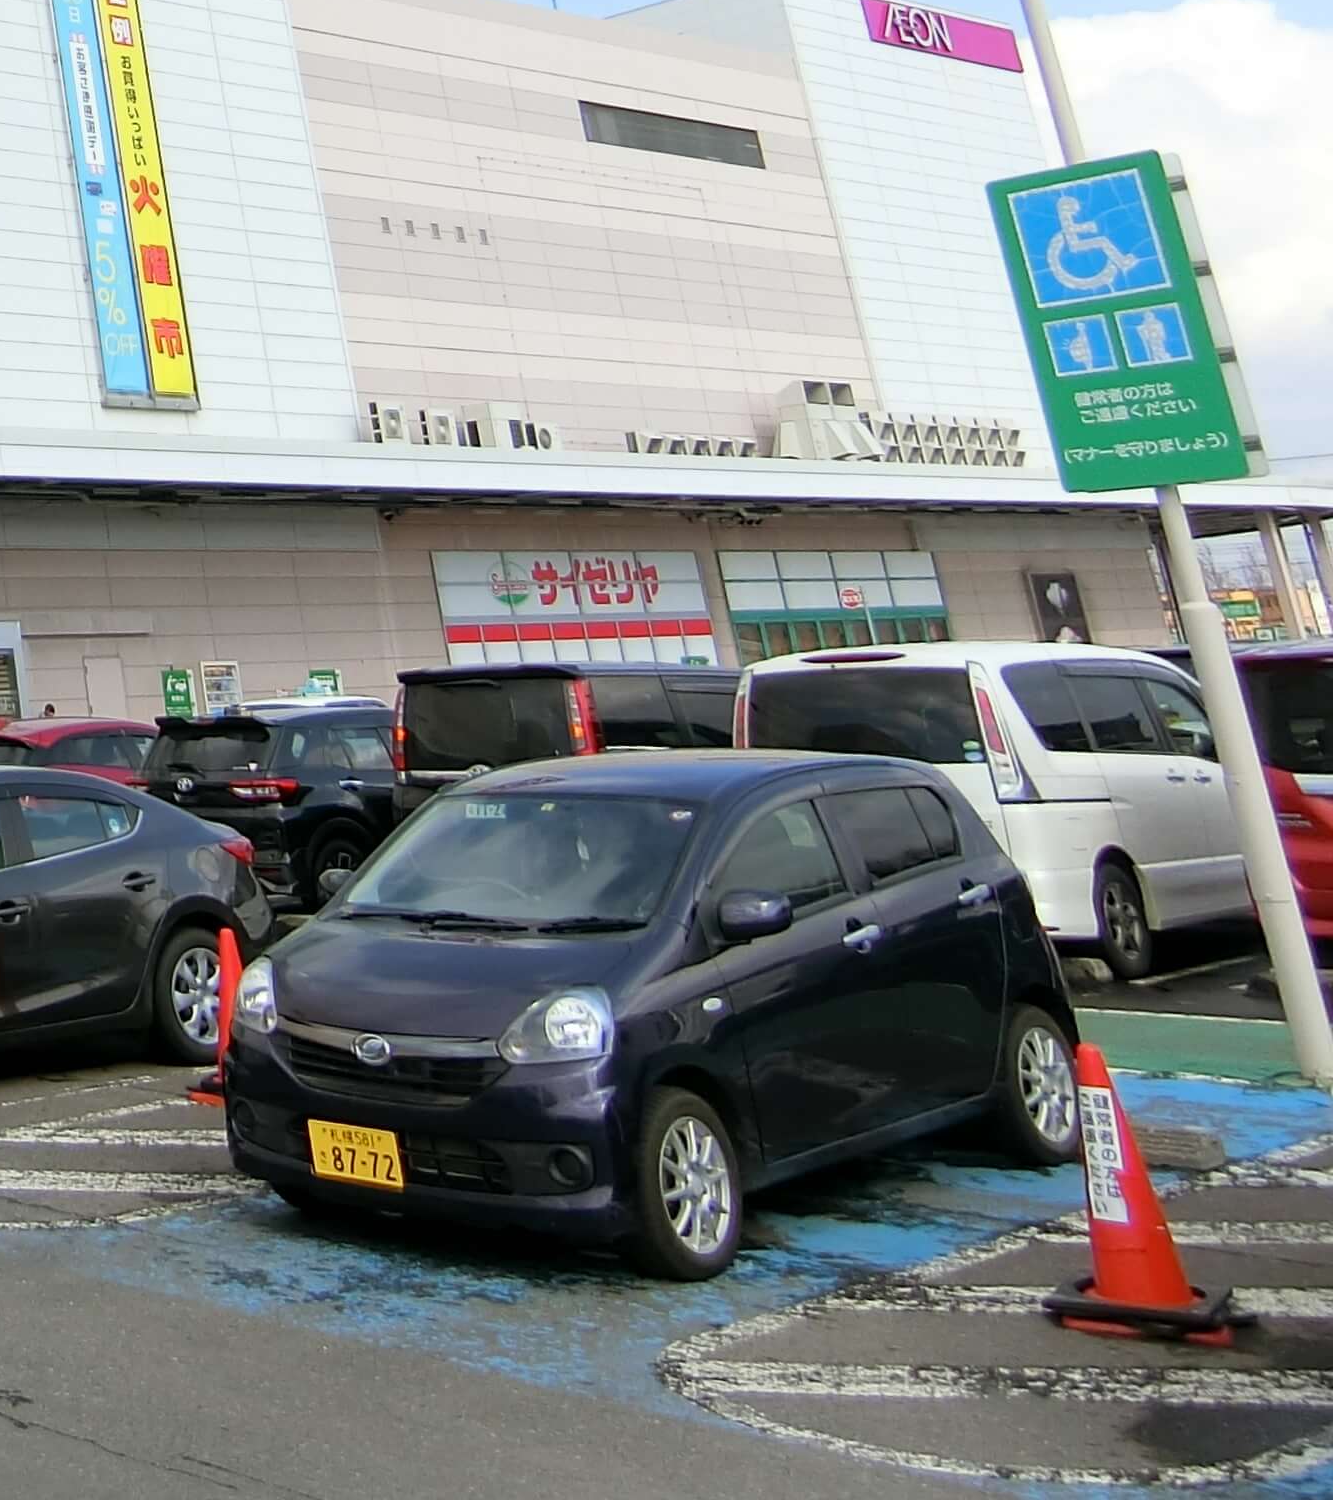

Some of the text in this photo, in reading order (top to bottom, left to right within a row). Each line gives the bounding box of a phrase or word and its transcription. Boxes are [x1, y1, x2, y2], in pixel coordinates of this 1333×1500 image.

[129, 175, 184, 358] 火曜市
[531, 556, 660, 606] サイゼリヤ
